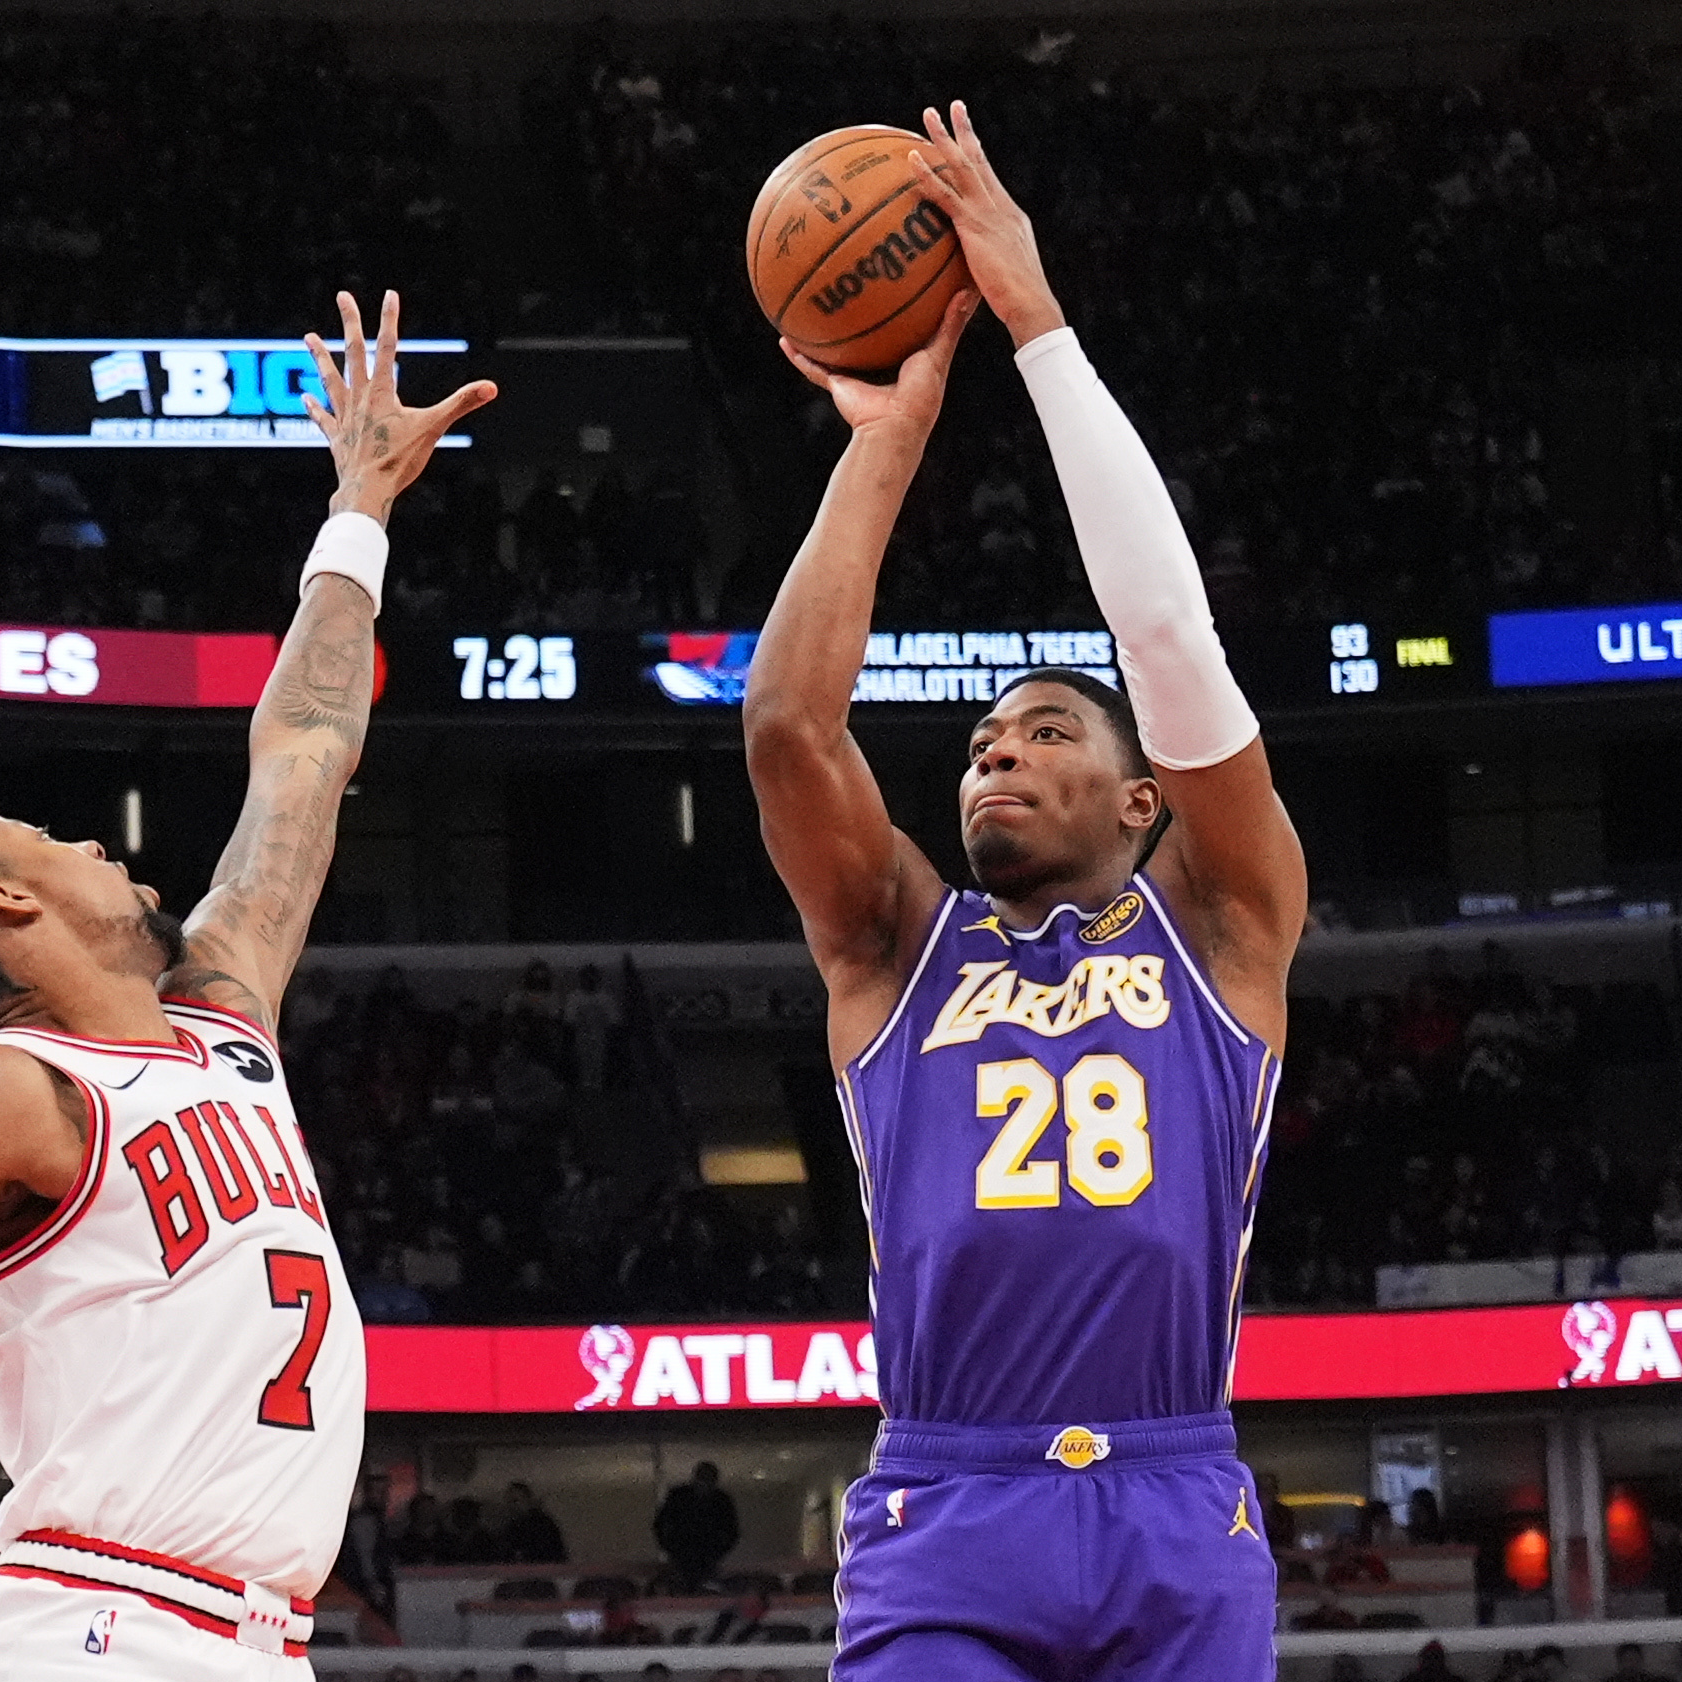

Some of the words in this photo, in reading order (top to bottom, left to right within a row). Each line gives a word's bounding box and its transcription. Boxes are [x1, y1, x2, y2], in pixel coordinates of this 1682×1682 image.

[453, 636, 576, 700] 7:25
[862, 632, 1027, 666] HILADELPHIA
[1027, 631, 1112, 665] 76ERS
[920, 954, 1171, 1055] LAKERS
[121, 1100, 327, 1279] BULL
[975, 1053, 1153, 1210] 28
[257, 1248, 332, 1432] 7
